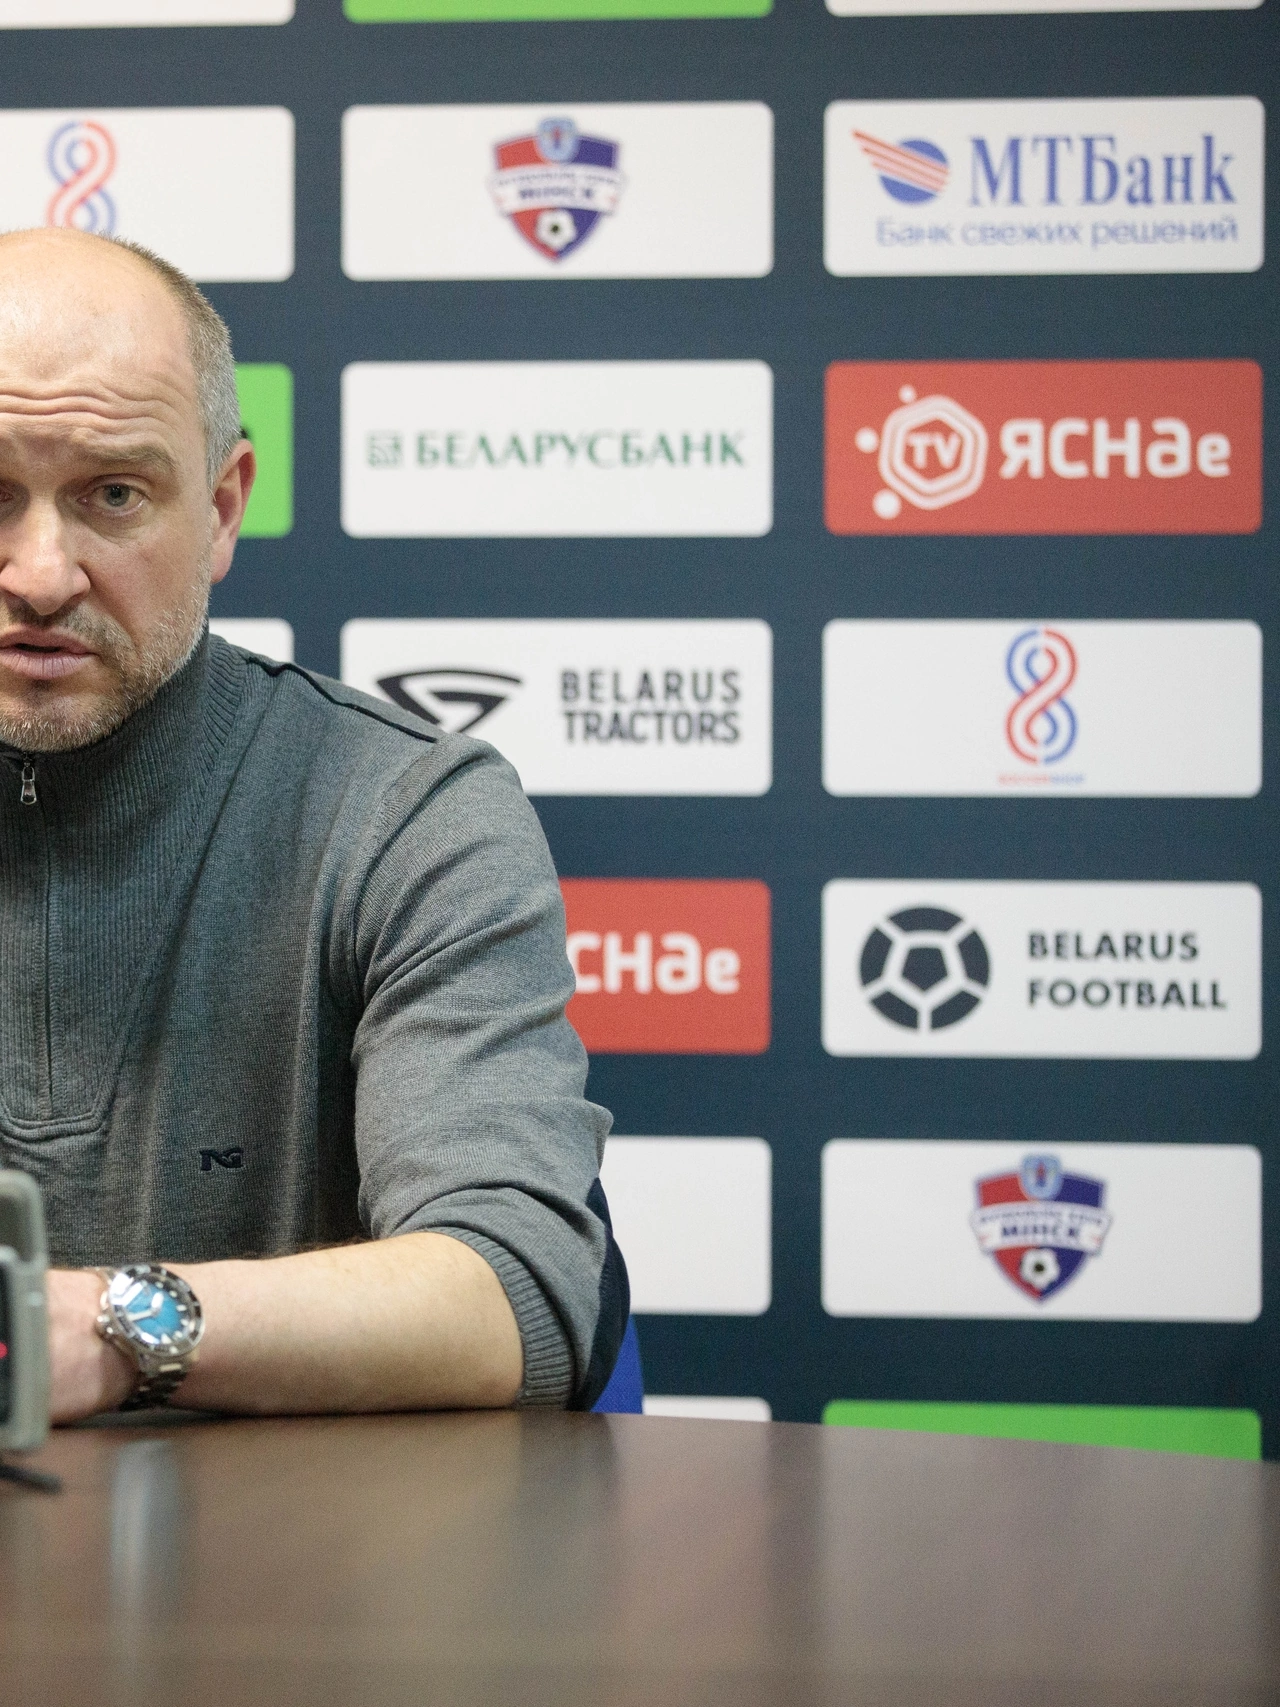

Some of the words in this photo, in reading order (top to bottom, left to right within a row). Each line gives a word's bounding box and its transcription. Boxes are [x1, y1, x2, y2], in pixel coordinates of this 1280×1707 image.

[969, 134, 1237, 207] МТБанк
[875, 217, 954, 247] Банк
[961, 222, 1083, 247] свежих
[1091, 216, 1240, 251] решений
[414, 431, 747, 468] БЕЛАРУСБАНК
[906, 432, 961, 469] TV
[560, 667, 740, 703] BELARUS
[563, 710, 740, 744] TRACTORS
[1028, 931, 1200, 962] BELARUS
[1028, 979, 1228, 1009] FOOTBALL
